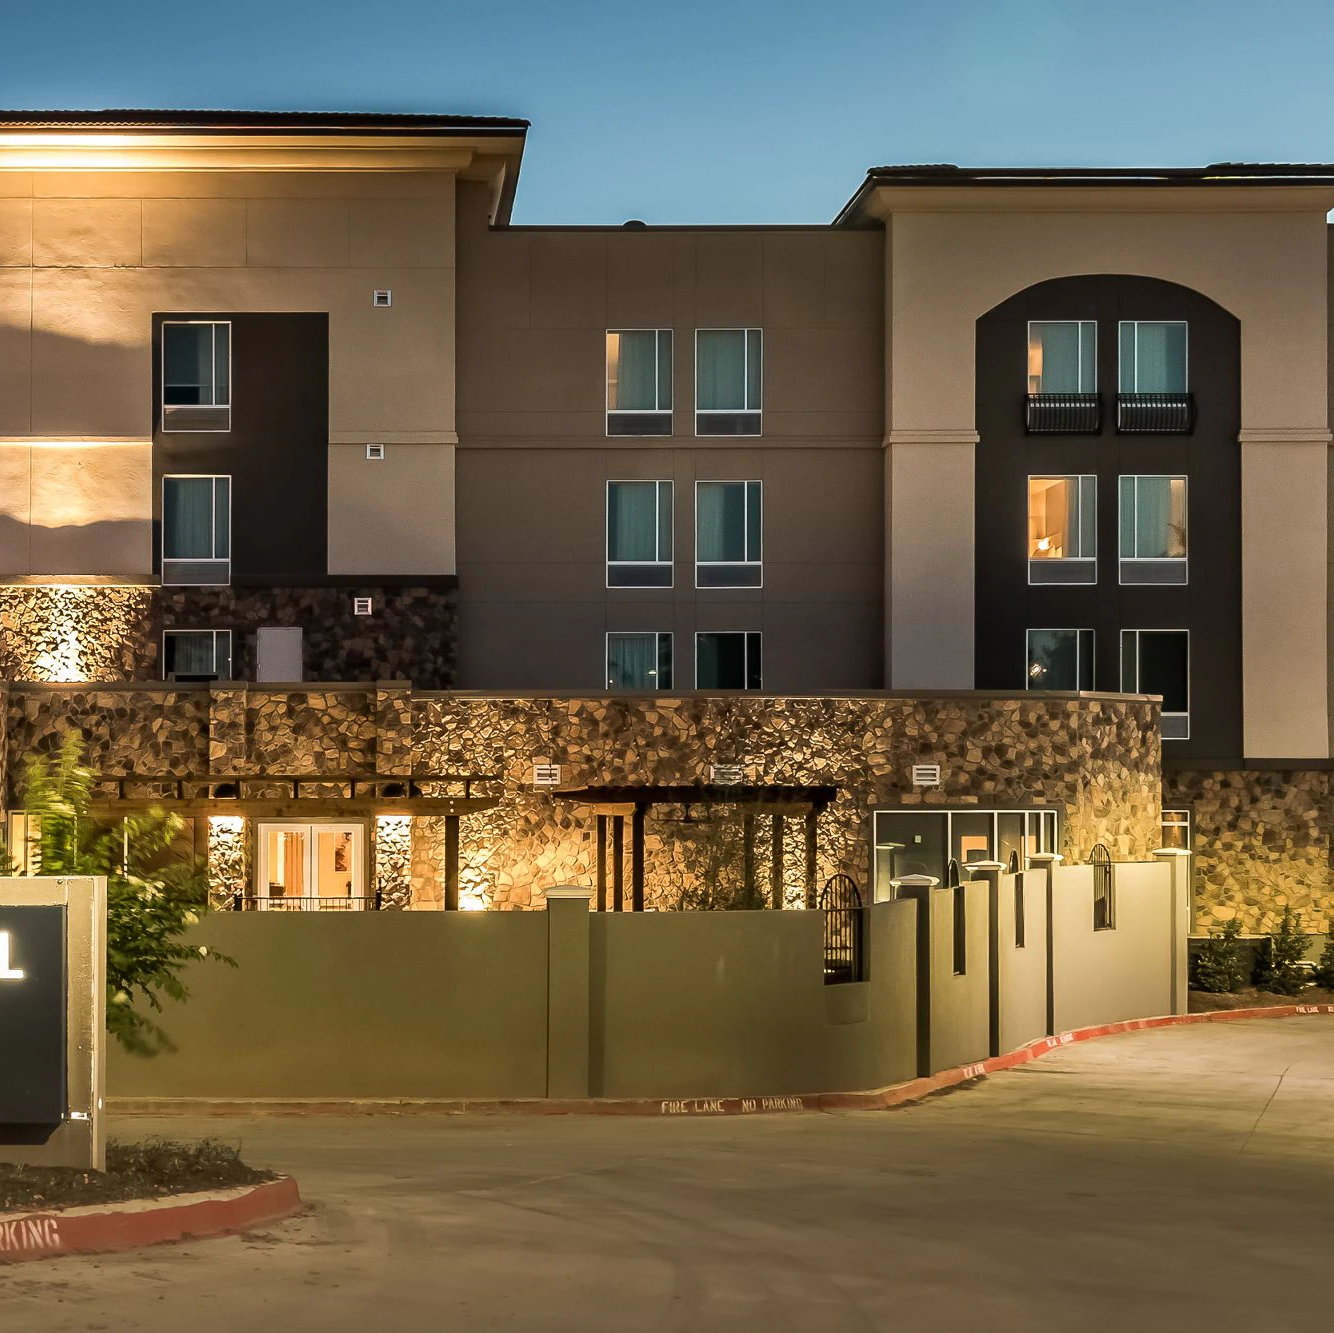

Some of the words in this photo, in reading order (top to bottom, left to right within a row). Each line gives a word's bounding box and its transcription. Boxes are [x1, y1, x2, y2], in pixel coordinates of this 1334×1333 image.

[661, 1100, 688, 1114] FIRE
[695, 1099, 725, 1113] LANE
[742, 1099, 756, 1113] NO
[762, 1097, 803, 1110] PARKING
